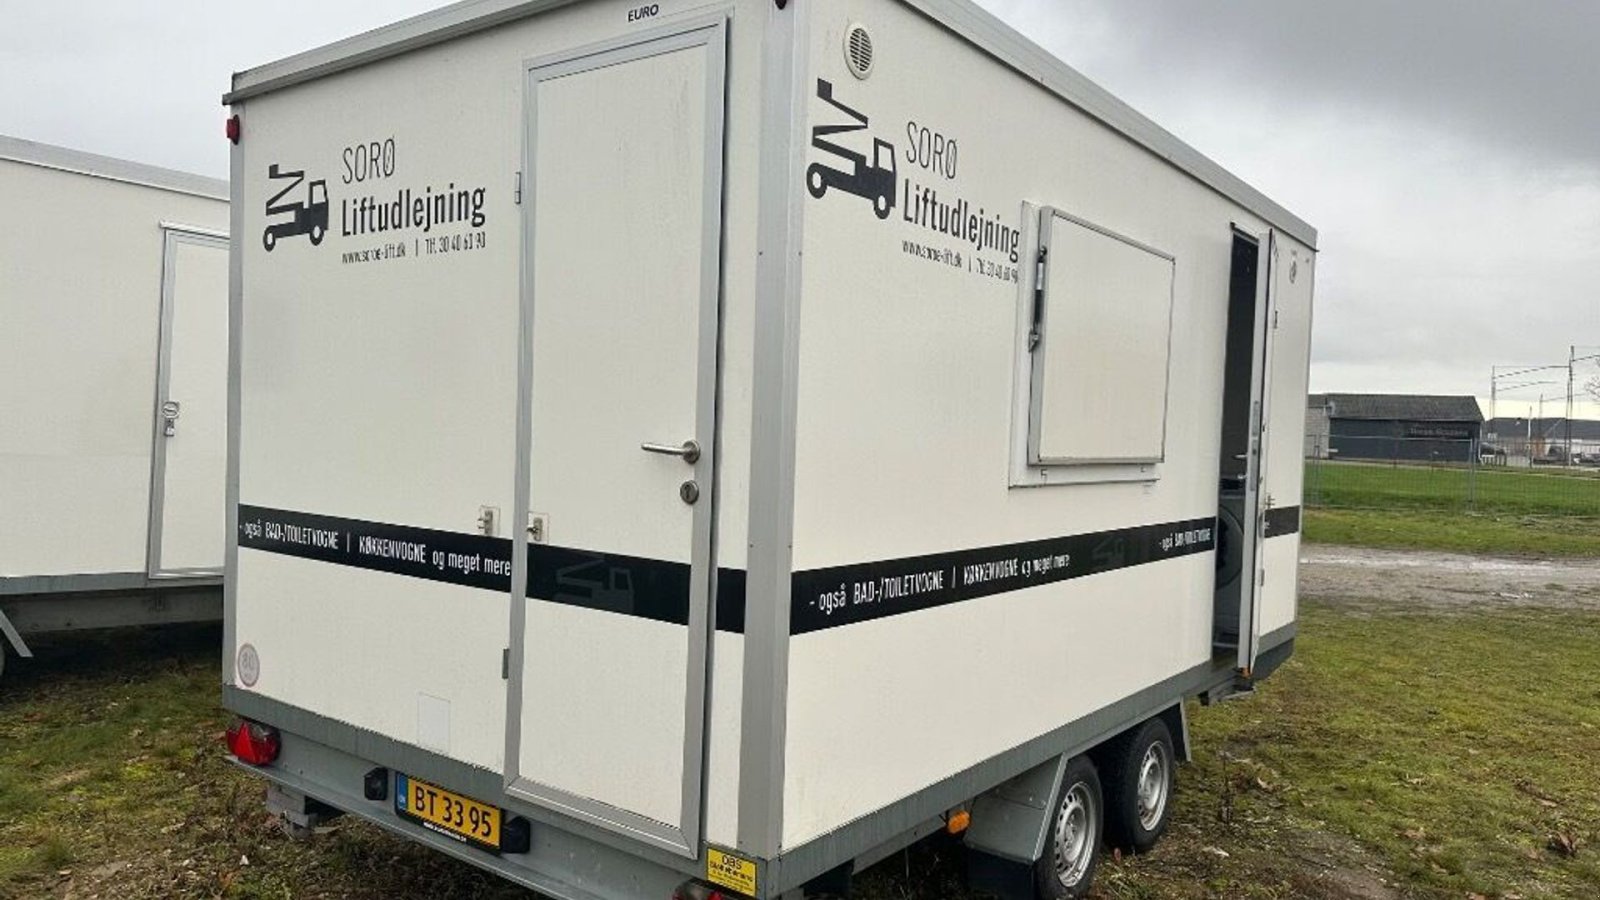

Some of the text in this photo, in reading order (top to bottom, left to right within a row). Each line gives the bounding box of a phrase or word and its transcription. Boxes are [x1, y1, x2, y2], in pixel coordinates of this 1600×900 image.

[628, 4, 659, 22] EURO
[342, 135, 396, 184] SORØ
[905, 120, 958, 180] SORØ
[342, 183, 486, 238] Liftudlejning
[903, 178, 1020, 263] Liftudlejning
[359, 535, 427, 564] KØKKENVOGNE
[432, 551, 445, 570] og
[448, 552, 481, 575] meget
[484, 557, 511, 577] mere
[819, 583, 846, 615] også
[853, 570, 944, 605] BAD-/TOILETVOGNE
[415, 785, 438, 816] BT
[442, 796, 464, 828] 33
[469, 806, 492, 837] 95
